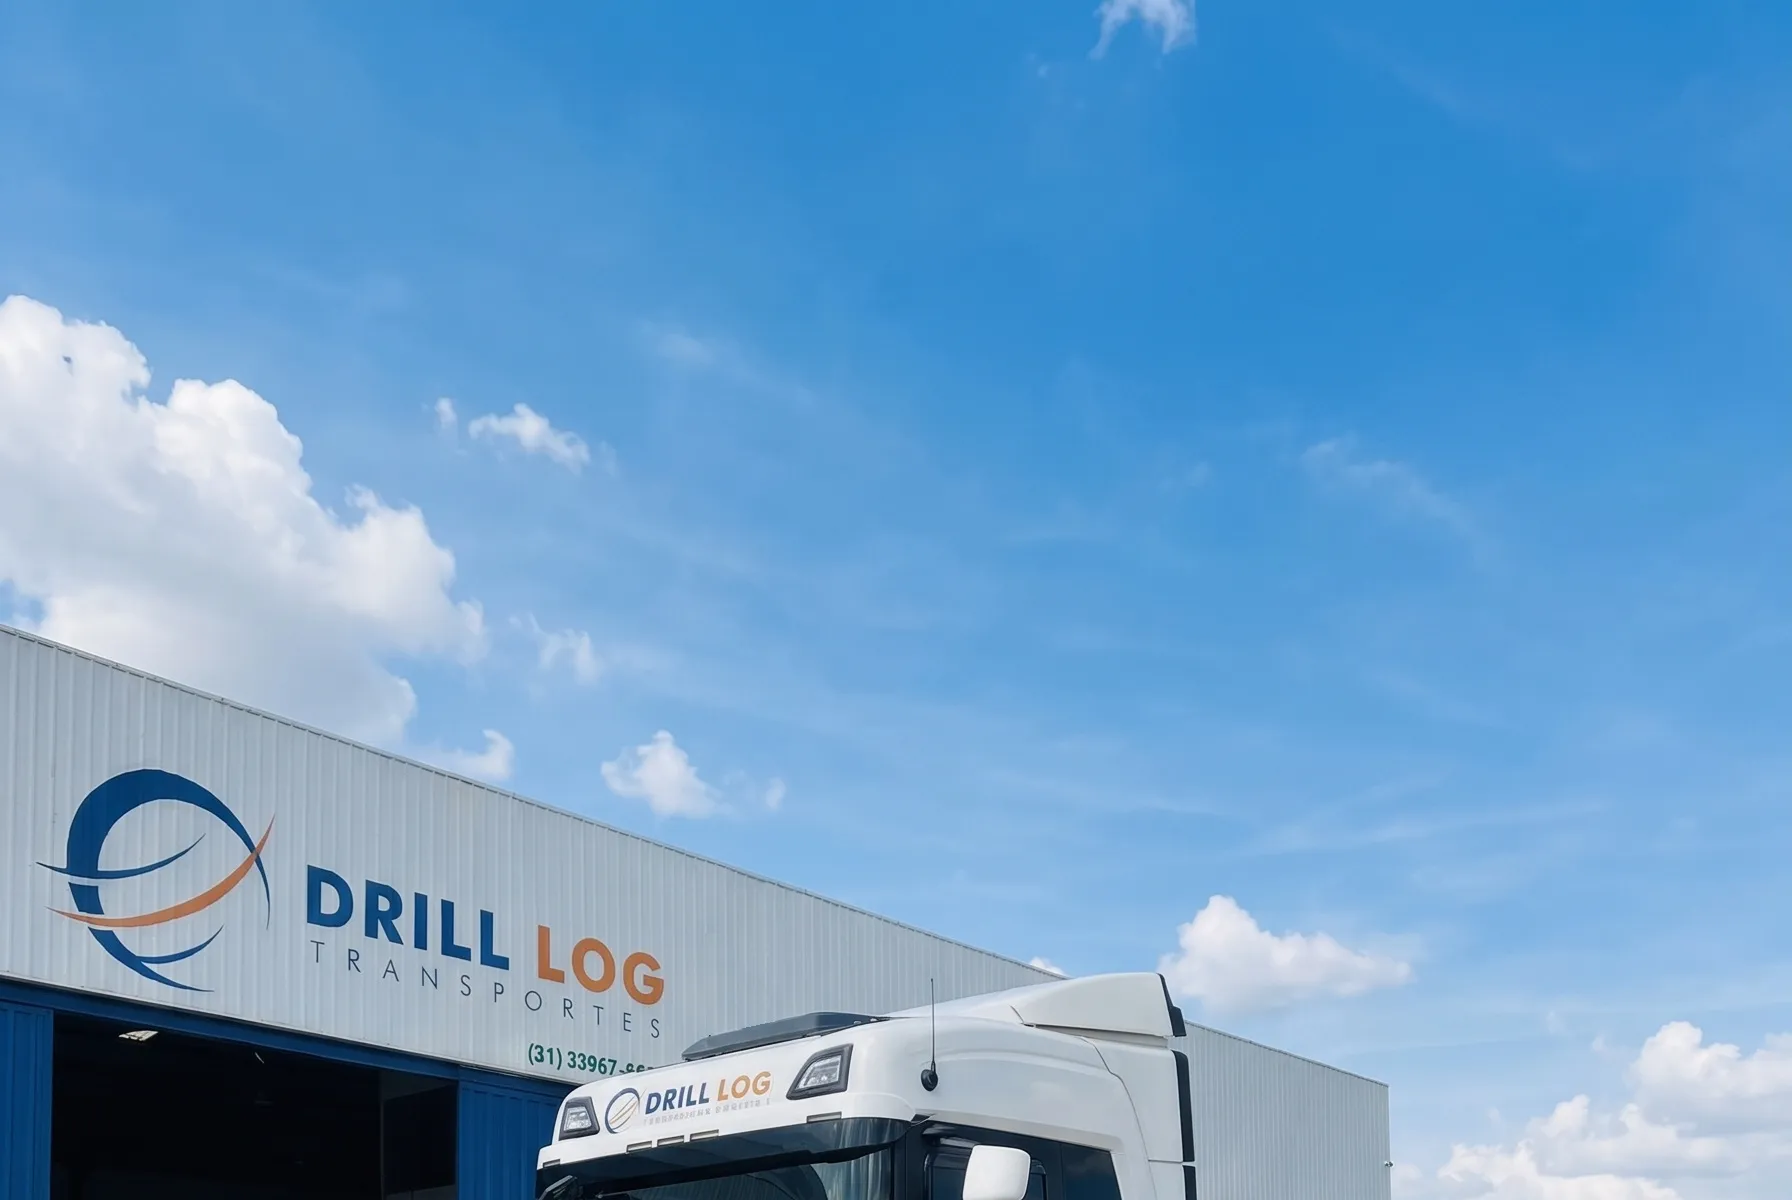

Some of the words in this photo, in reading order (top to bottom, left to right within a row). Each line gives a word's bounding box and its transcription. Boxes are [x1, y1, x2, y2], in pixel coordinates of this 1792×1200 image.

[307, 864, 509, 971] DRILL
[537, 925, 664, 1005] LOG
[310, 940, 660, 1038] TRANSPORTES
[528, 1043, 562, 1070] (31)
[645, 1082, 710, 1115] DRILL
[717, 1071, 771, 1102] LOG
